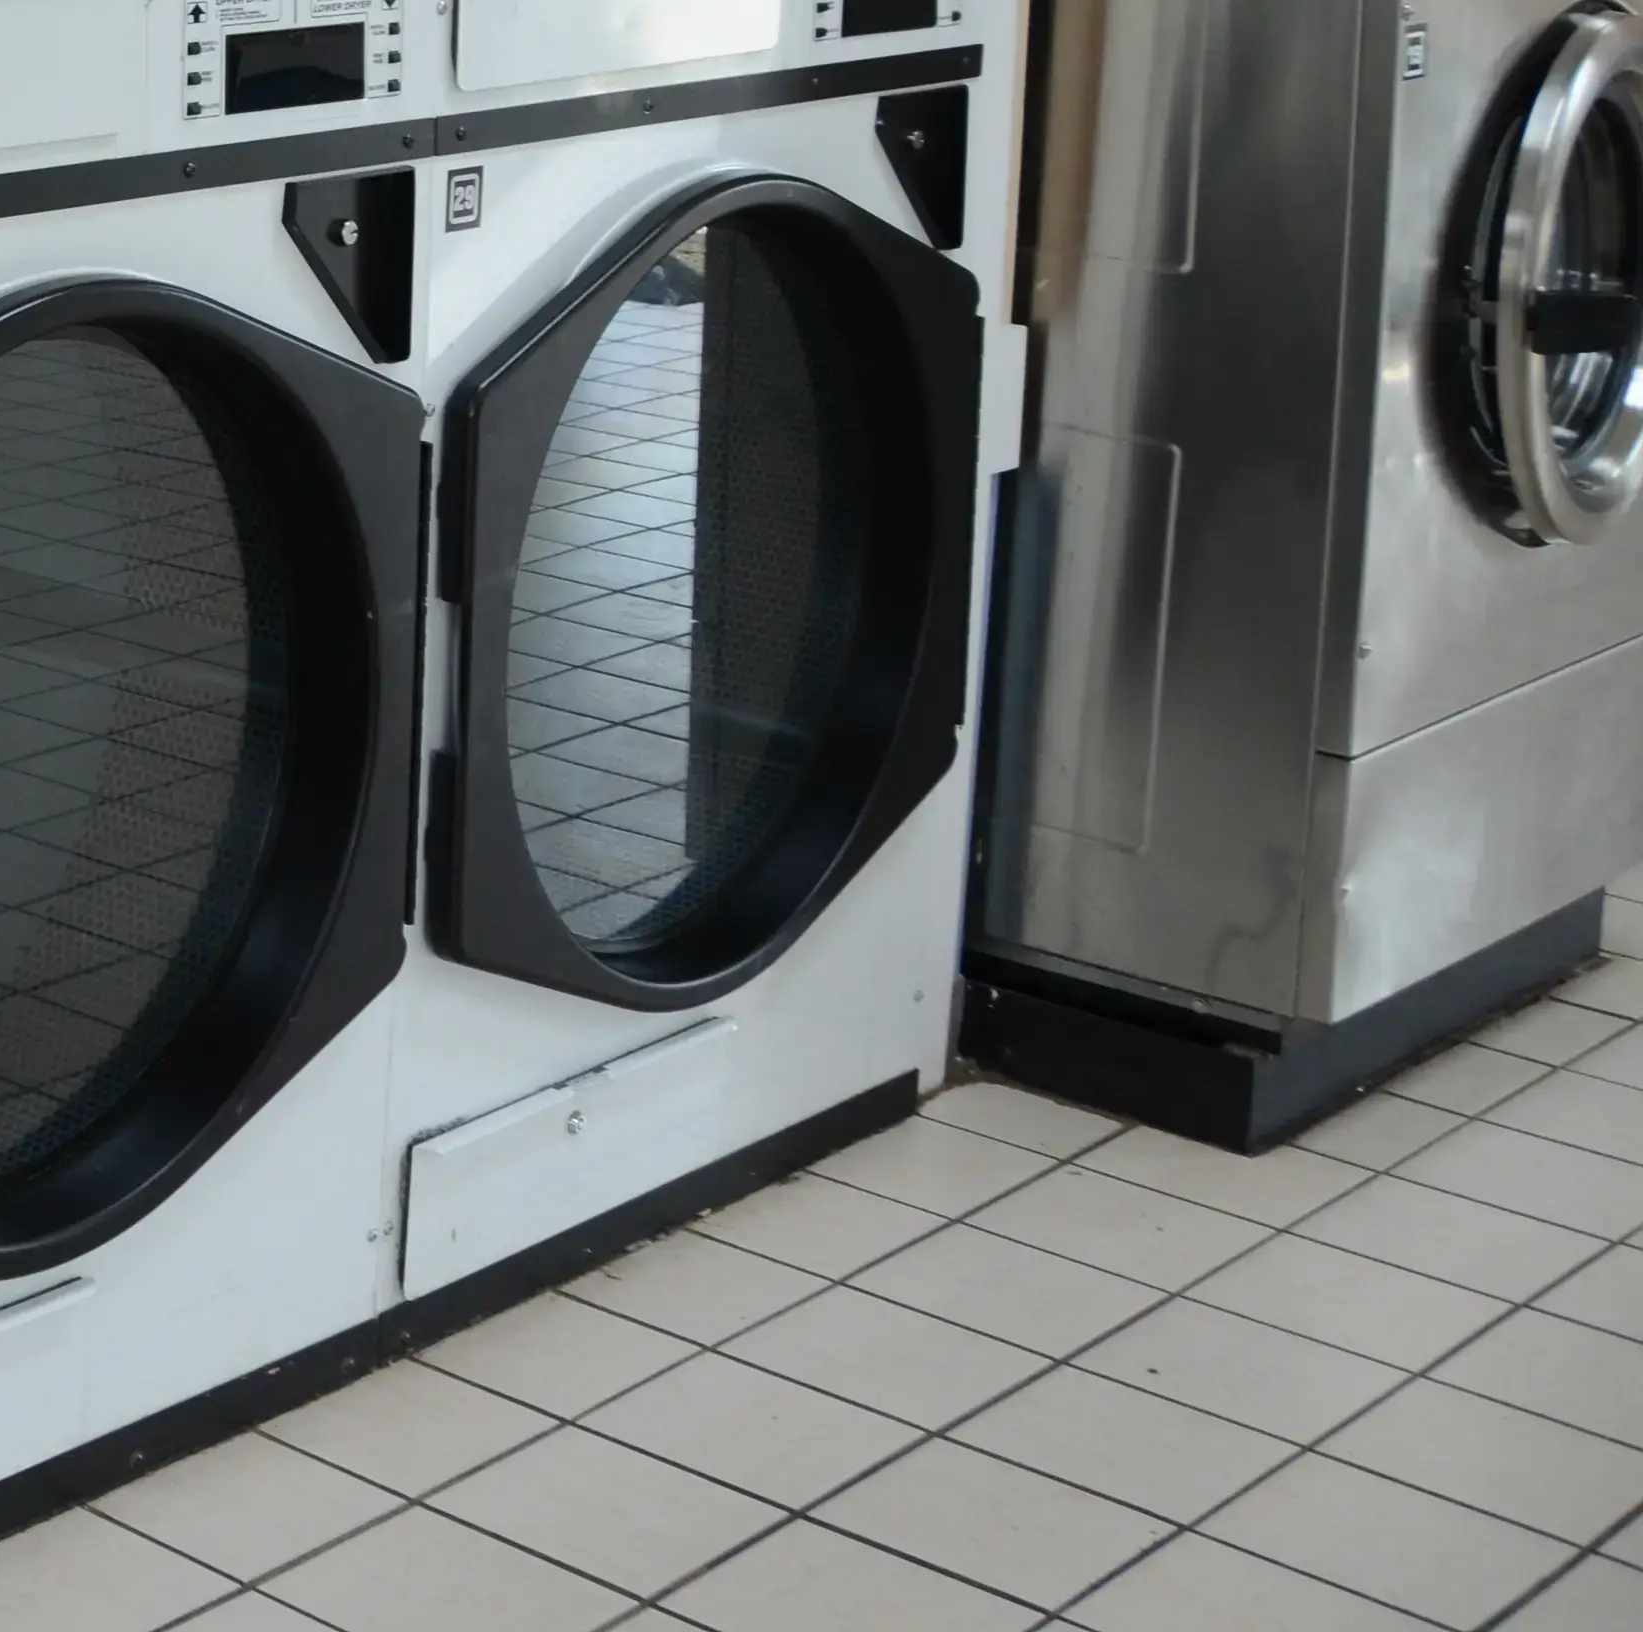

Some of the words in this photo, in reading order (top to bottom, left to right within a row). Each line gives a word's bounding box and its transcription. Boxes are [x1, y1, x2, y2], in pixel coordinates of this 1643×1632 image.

[314, 2, 343, 13] LOWER
[344, 0, 372, 10] DRYER
[453, 184, 475, 211] 29
